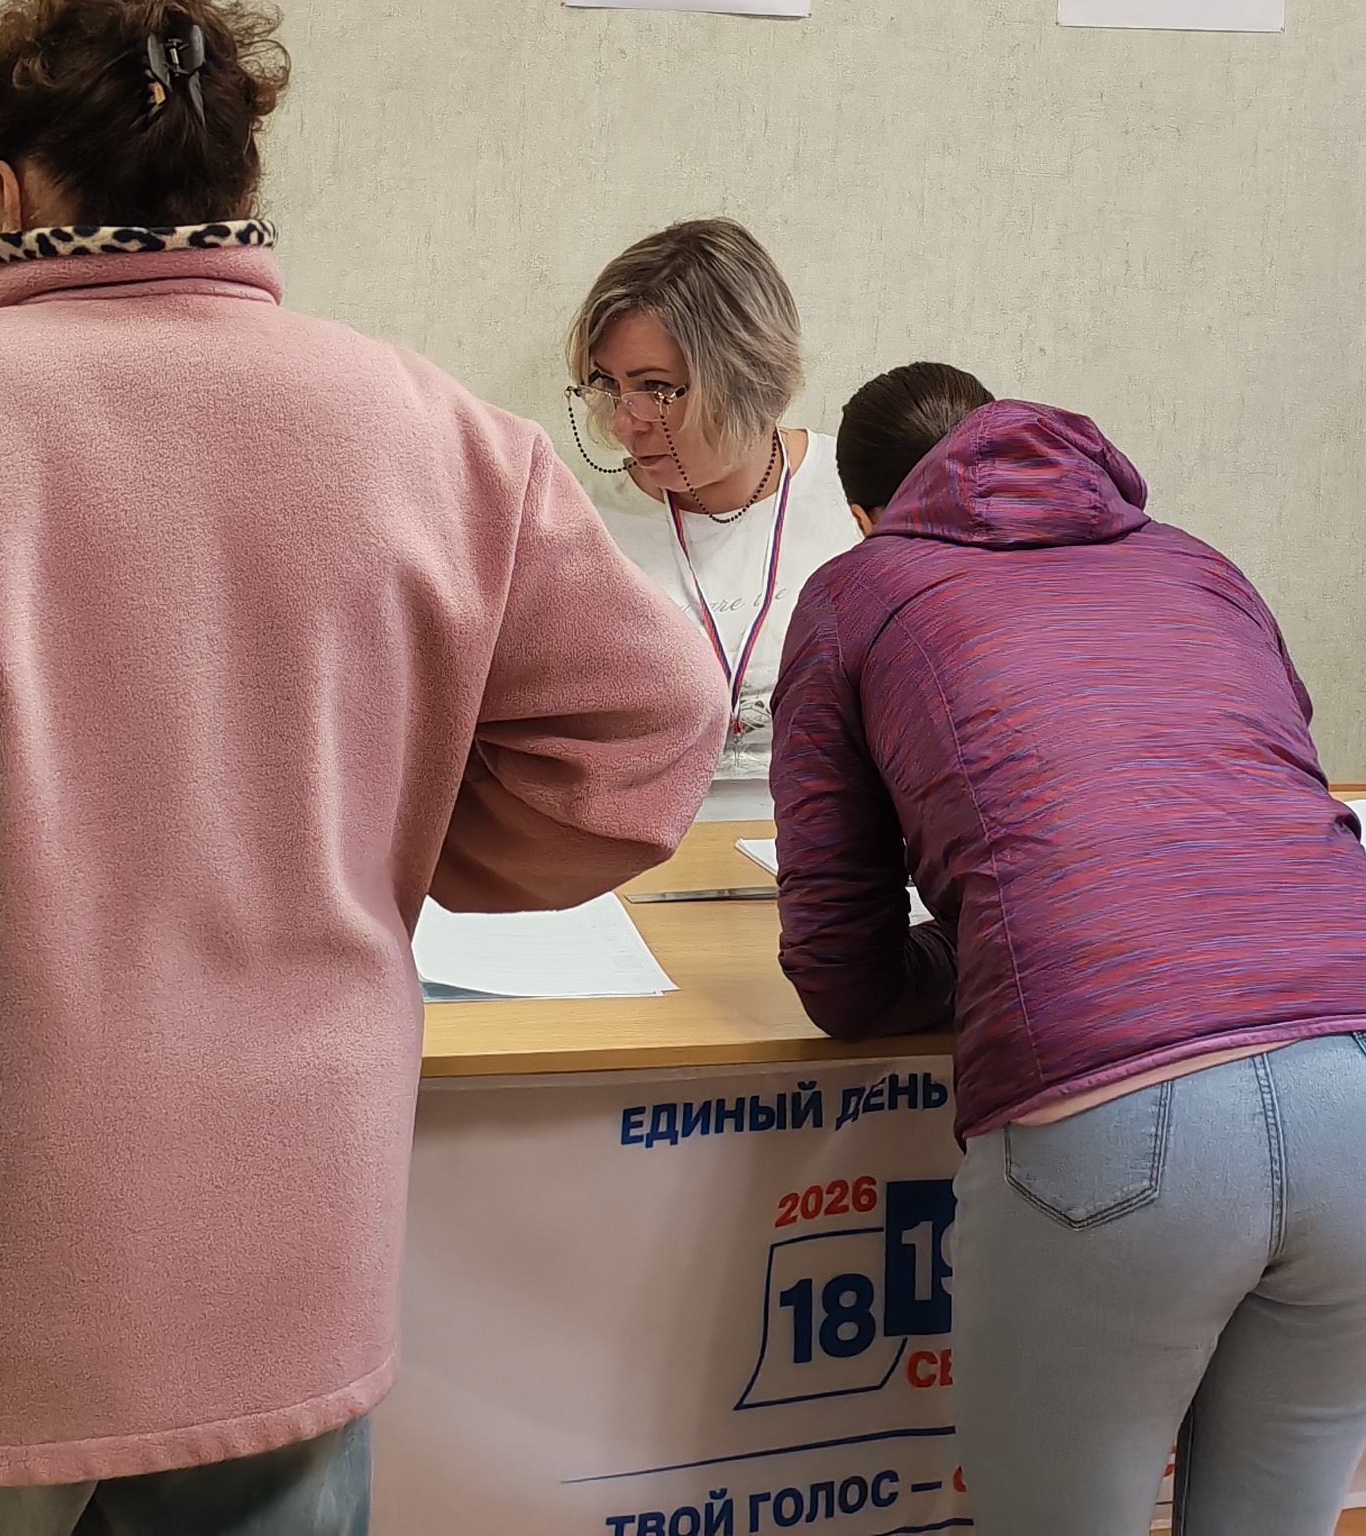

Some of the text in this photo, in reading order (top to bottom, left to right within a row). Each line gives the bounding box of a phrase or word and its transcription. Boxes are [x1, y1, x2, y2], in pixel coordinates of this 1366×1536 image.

[620, 1072, 948, 1150] ЕДИНЫЙ ДЕНЬ
[774, 1175, 878, 1228] 2026
[779, 1273, 876, 1364] 18
[749, 1470, 899, 1532] ГОЛОС
